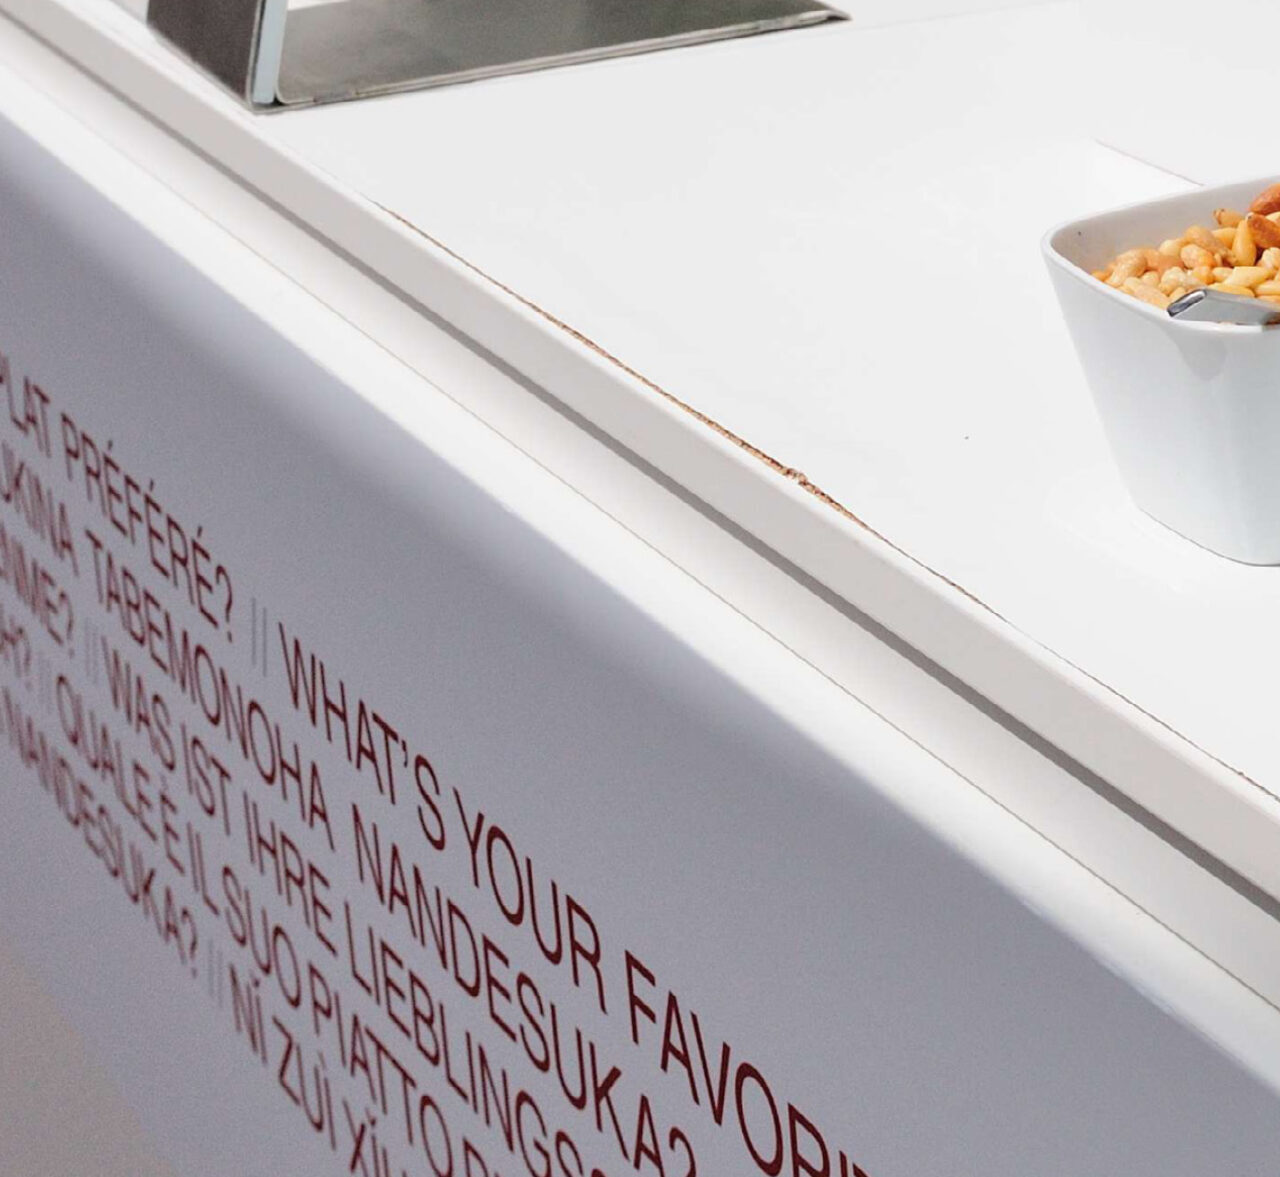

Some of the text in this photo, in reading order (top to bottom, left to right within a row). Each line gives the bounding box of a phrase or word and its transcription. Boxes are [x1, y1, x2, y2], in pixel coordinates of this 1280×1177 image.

[61, 412, 232, 643] PRÉFÉRÉ?
[278, 622, 446, 851] WHAT'S
[453, 786, 607, 1014] YOUR
[86, 530, 334, 852] TABEMONOHA
[102, 636, 176, 771] WAS
[180, 723, 231, 835] IST
[244, 790, 337, 957] IHRE
[187, 822, 220, 916] IL
[223, 866, 300, 1008] SUO
[308, 962, 453, 1177] PIATTO
